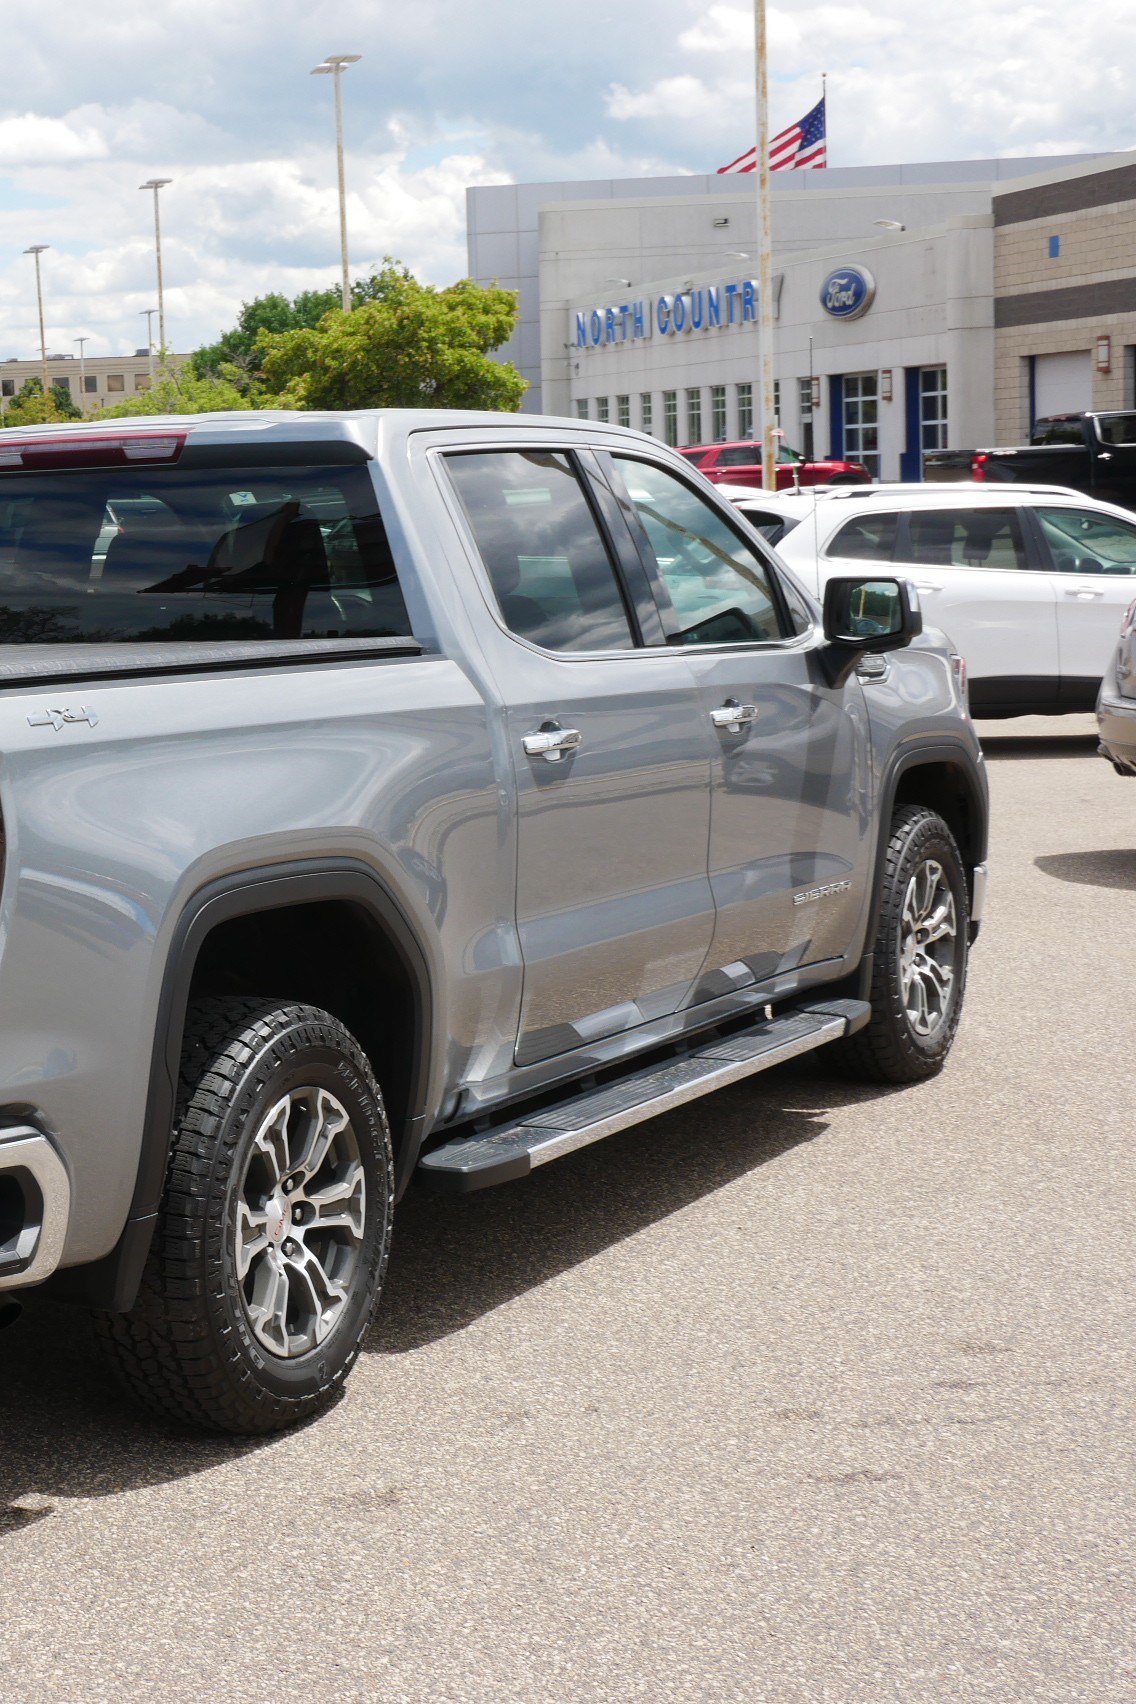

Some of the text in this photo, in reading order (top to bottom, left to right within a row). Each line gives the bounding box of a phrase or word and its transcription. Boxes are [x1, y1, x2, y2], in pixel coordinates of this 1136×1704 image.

[826, 278, 856, 309] Ford
[576, 299, 651, 348] NORTH
[792, 880, 853, 906] SIERRA
